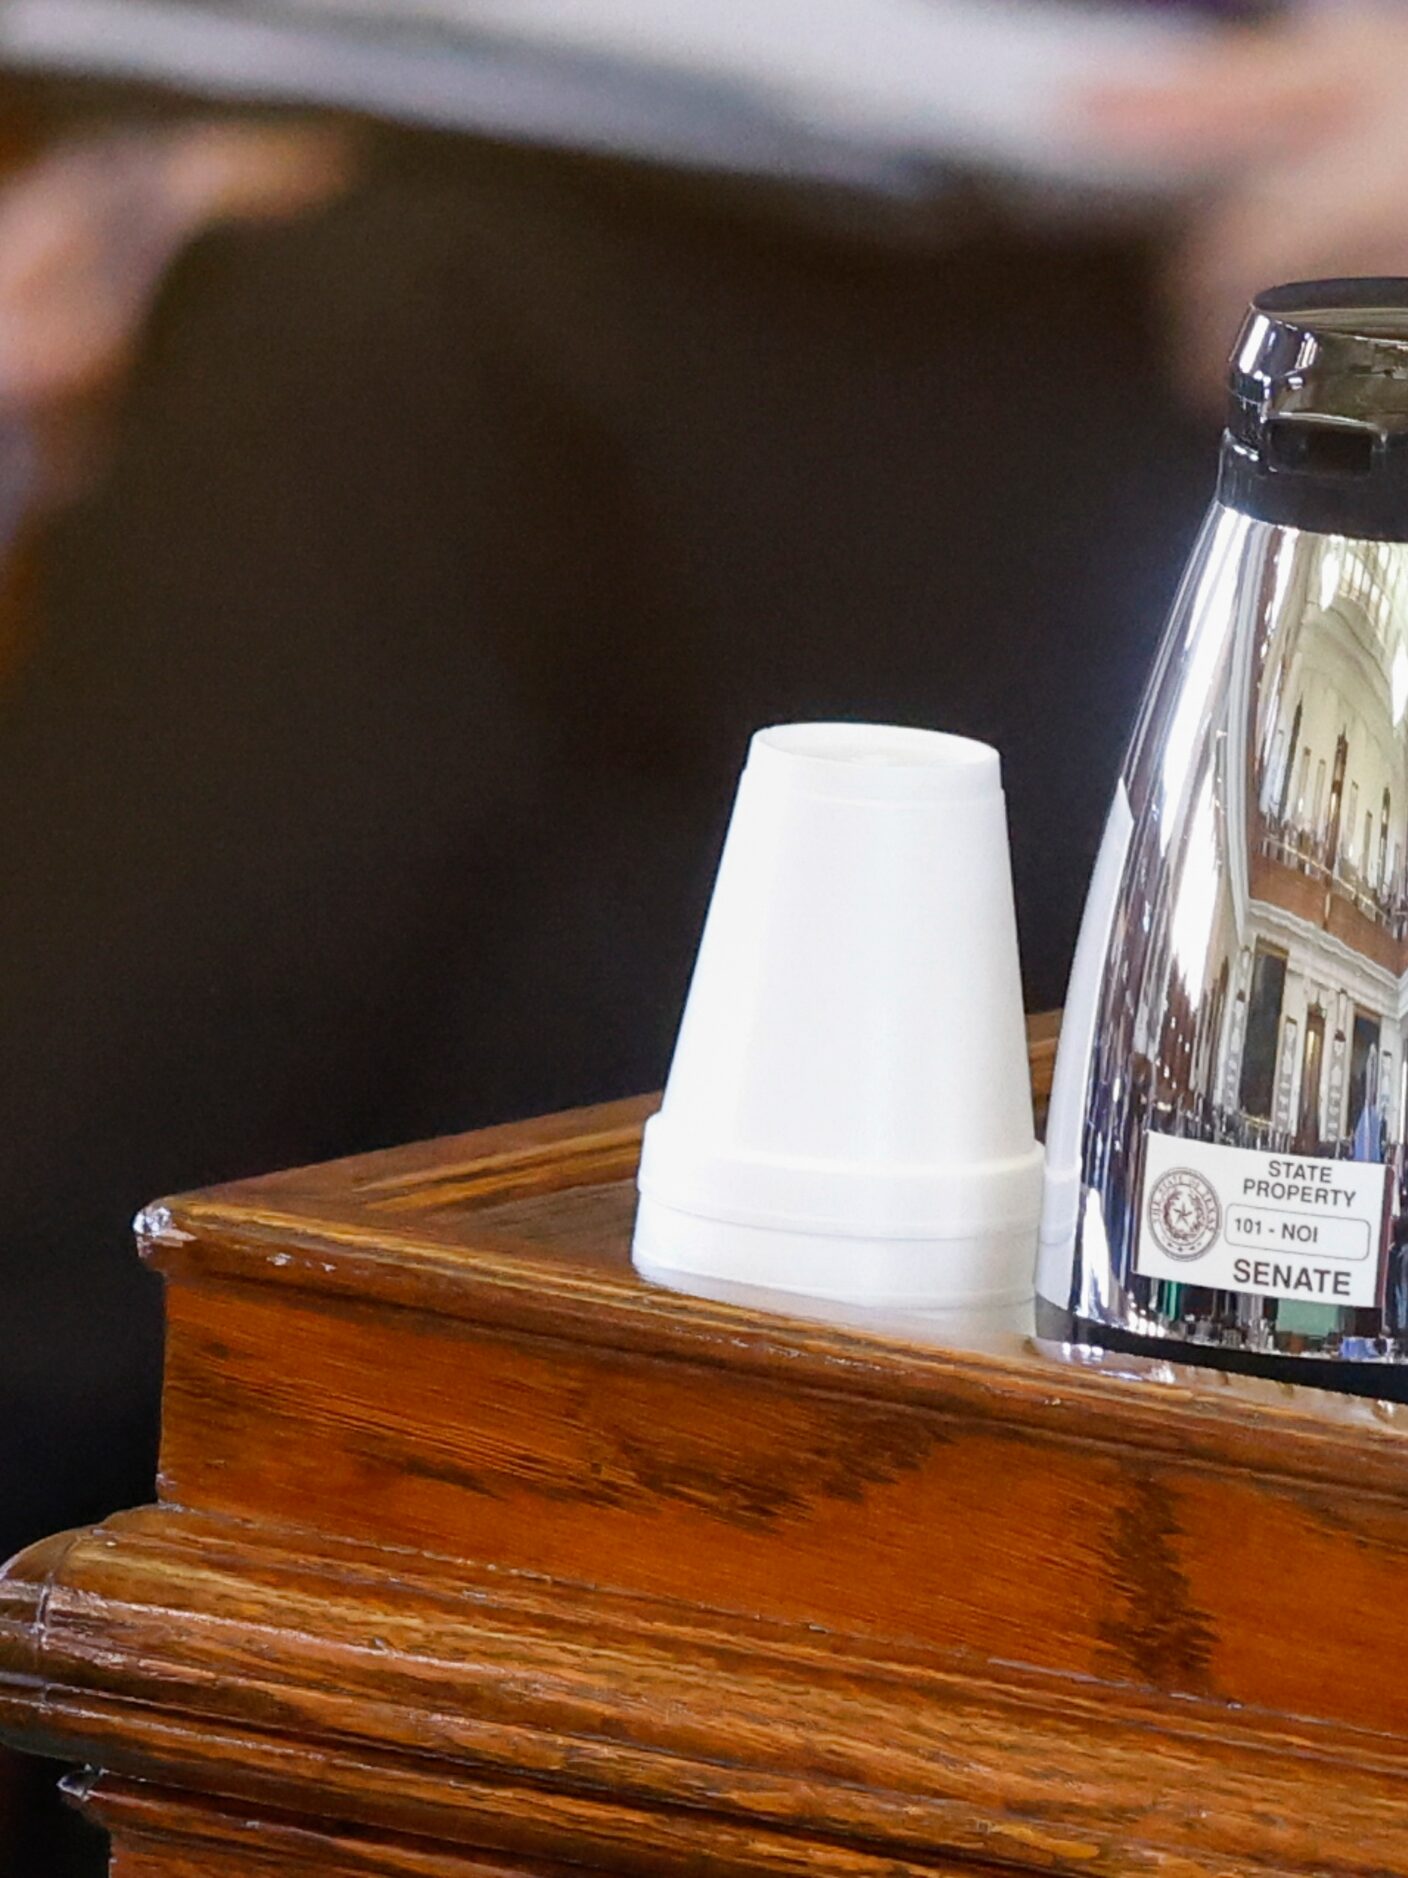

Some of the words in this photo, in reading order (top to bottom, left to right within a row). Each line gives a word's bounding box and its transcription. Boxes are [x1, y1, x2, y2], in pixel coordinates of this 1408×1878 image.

[1268, 1160, 1332, 1184] STATE
[1243, 1178, 1356, 1208] PROPERTY
[1235, 1218, 1262, 1236] 101
[1281, 1225, 1318, 1243] NOI
[1233, 1258, 1352, 1296] SENATE
